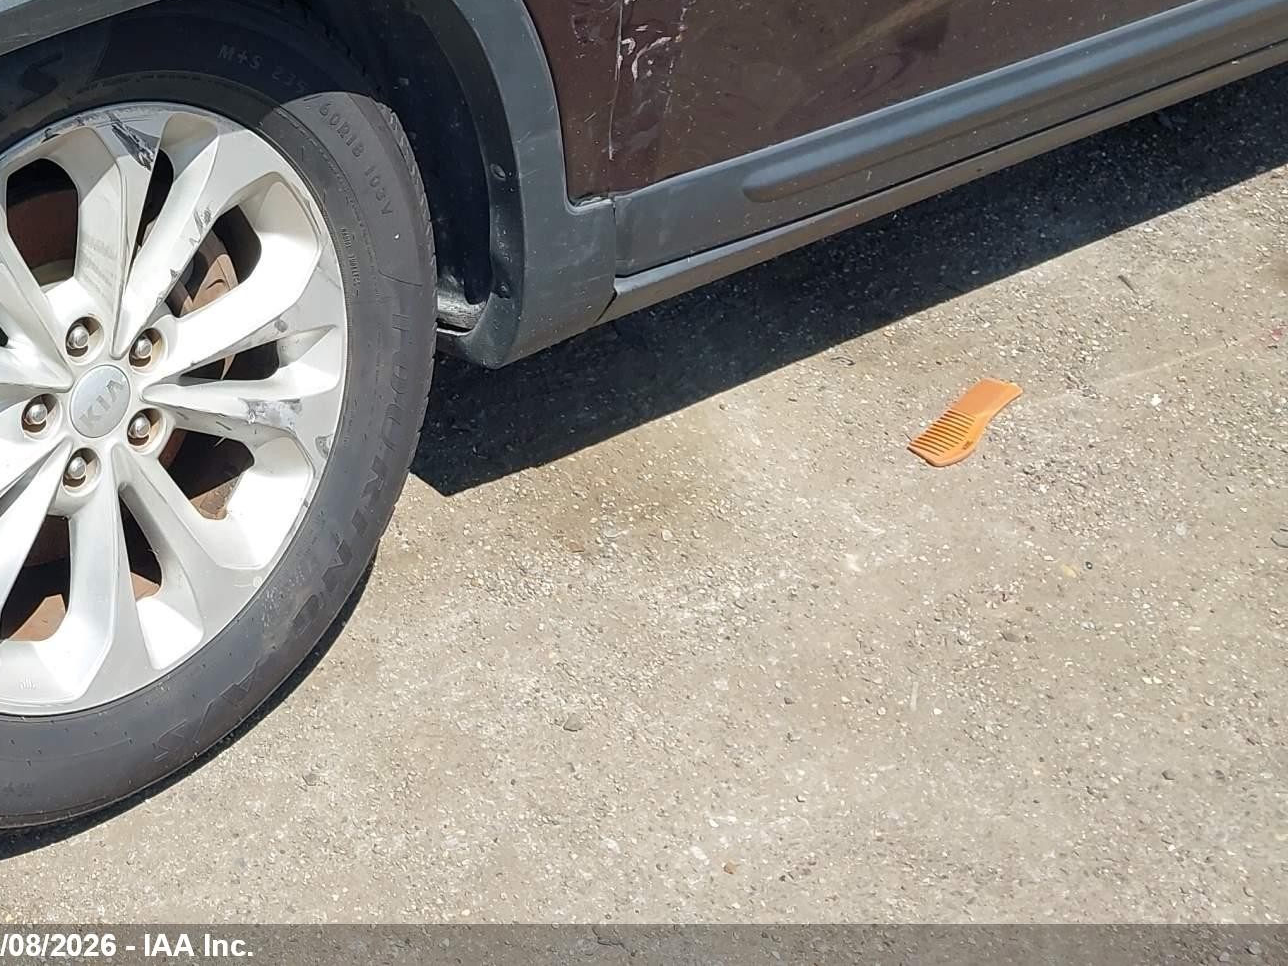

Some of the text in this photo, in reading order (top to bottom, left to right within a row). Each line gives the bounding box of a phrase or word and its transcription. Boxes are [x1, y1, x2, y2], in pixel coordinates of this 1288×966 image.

[217, 43, 265, 70] M+S
[365, 164, 394, 218] 103V
[78, 380, 125, 431] KIA
